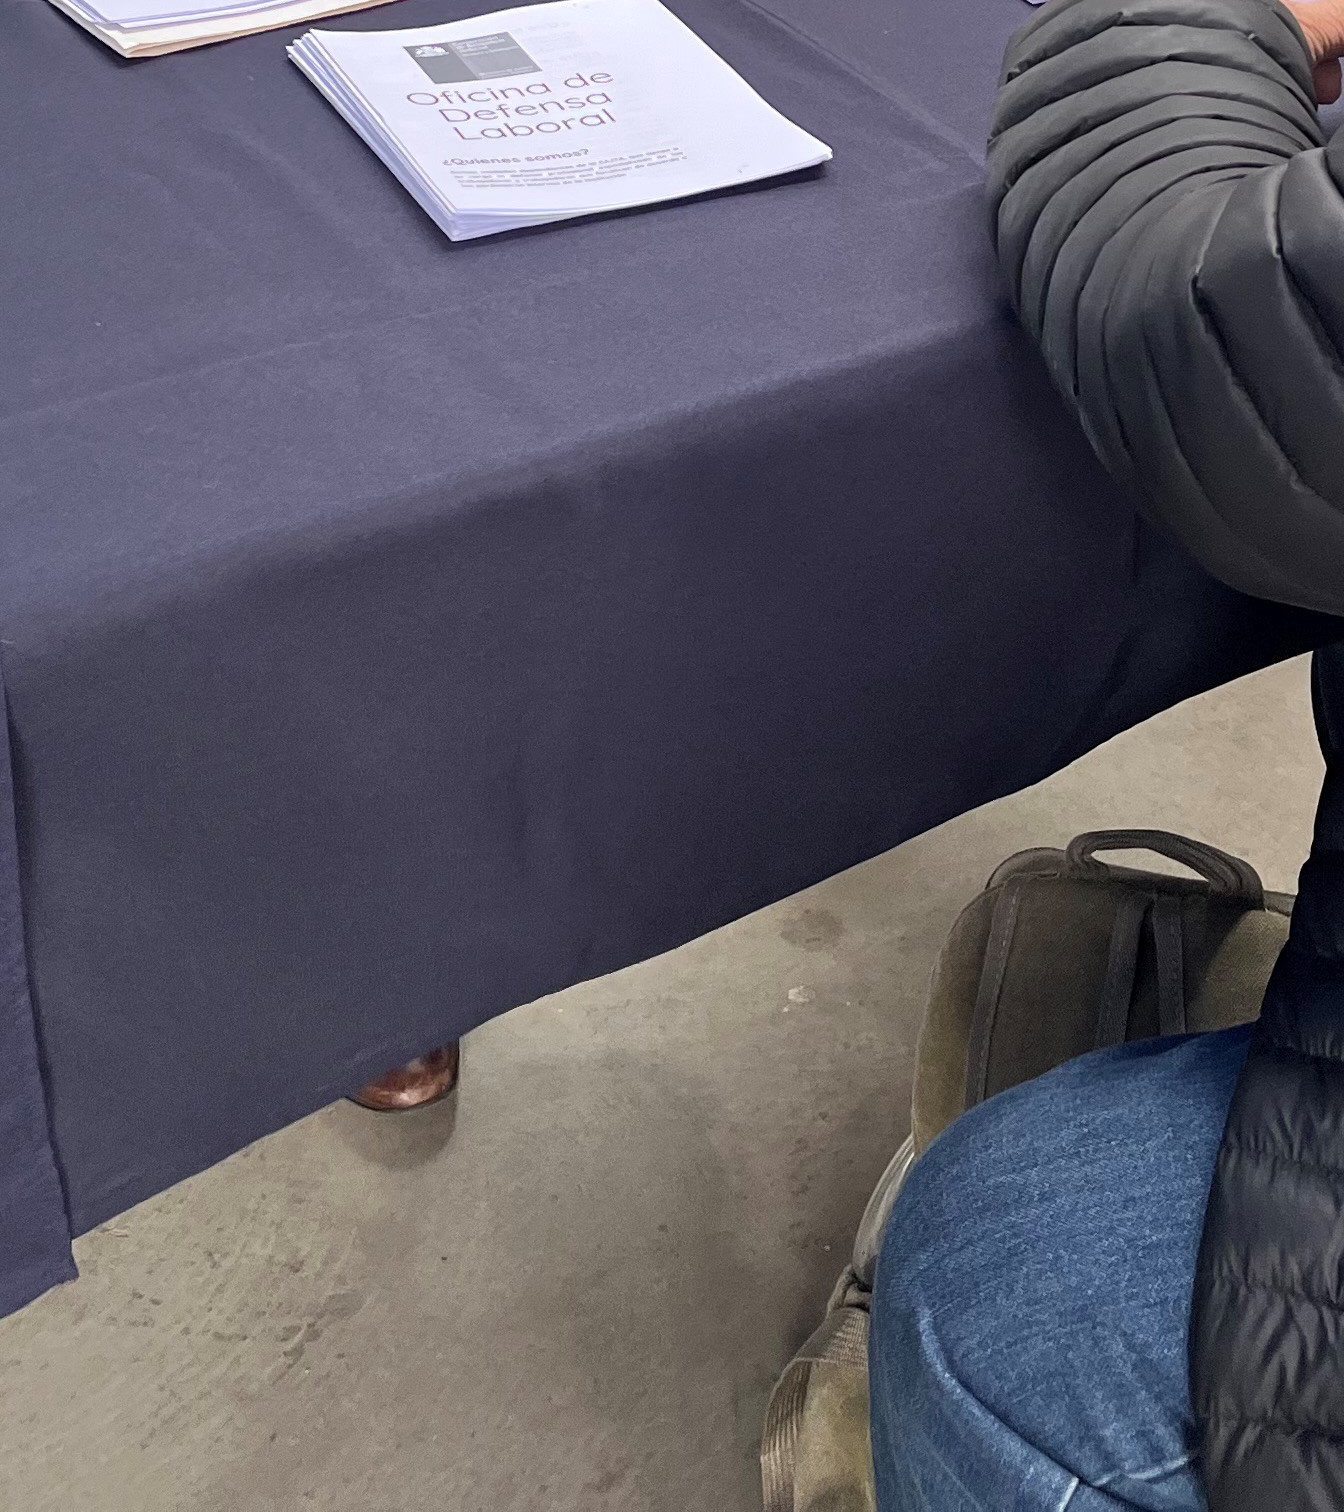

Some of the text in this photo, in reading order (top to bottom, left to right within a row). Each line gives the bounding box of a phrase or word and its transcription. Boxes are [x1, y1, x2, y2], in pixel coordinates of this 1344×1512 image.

[406, 72, 614, 106] Oficina de
[438, 91, 612, 123] Defensa
[453, 108, 617, 140] Laboral
[524, 148, 589, 162] somos?
